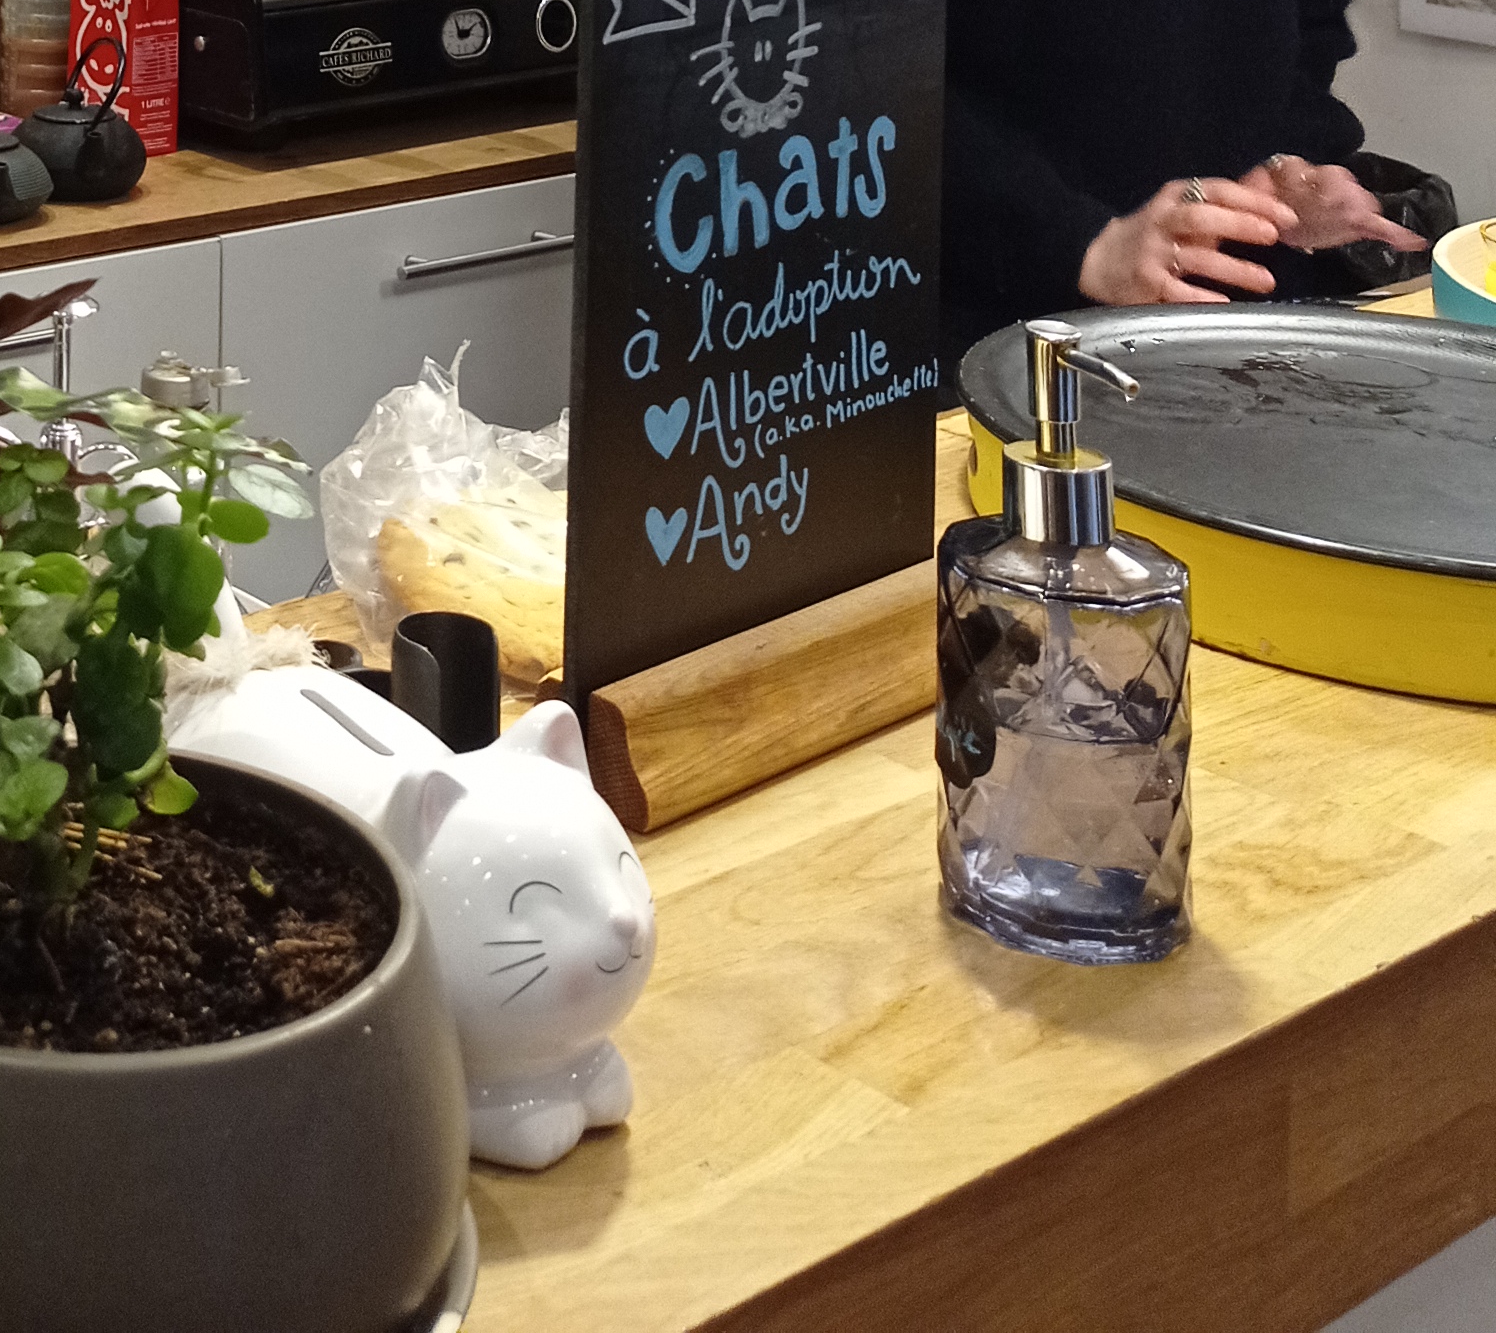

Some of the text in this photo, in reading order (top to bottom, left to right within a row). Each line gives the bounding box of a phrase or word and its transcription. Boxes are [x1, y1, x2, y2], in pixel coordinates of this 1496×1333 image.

[351, 47, 392, 64] RICHARD
[655, 115, 896, 274] Chats
[623, 250, 921, 380] à l'adoption
[690, 328, 890, 469] Albertville
[686, 453, 810, 573] Andy
